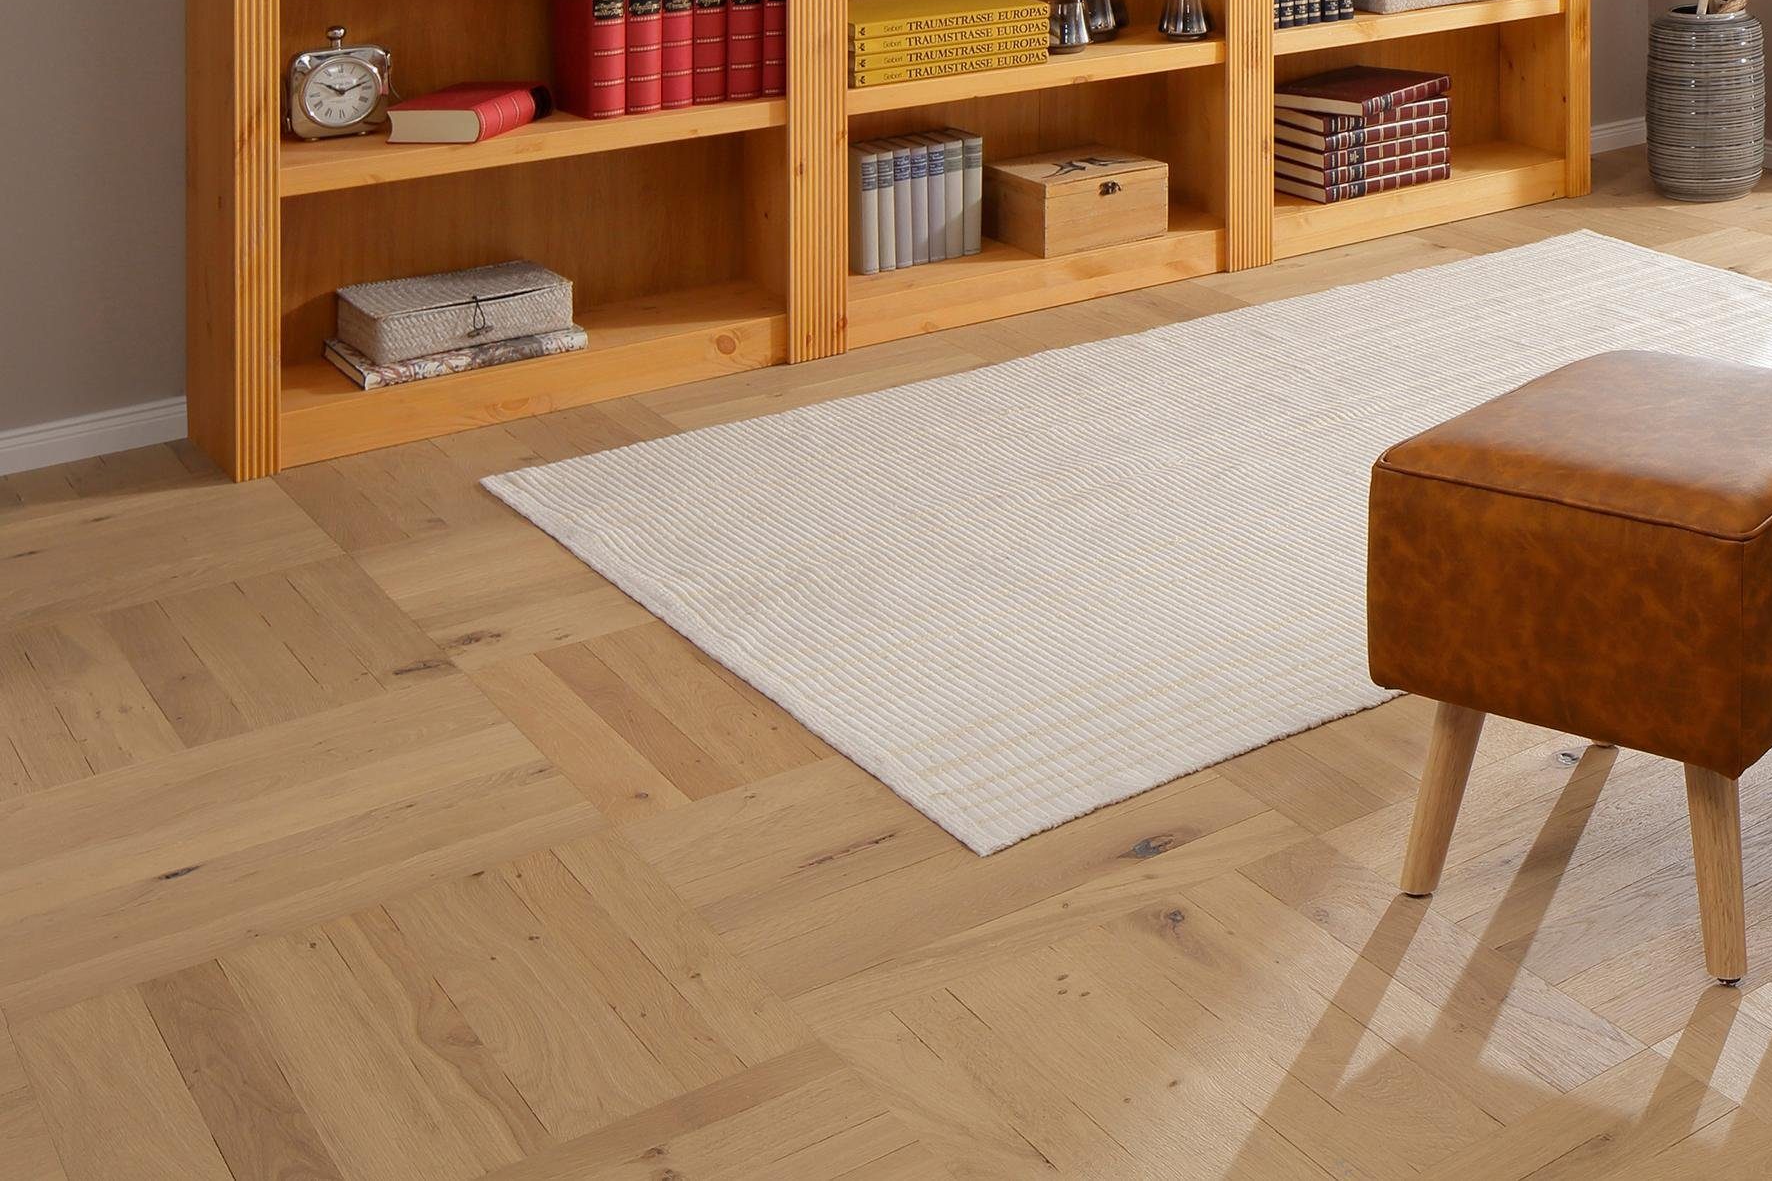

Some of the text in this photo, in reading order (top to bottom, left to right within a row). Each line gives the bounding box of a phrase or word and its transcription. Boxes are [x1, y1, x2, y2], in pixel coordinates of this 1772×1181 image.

[906, 13, 994, 32] TRAUMSTRASSE
[998, 6, 1048, 21] EUROPAS
[906, 27, 992, 47] TRAUMSTRASSE
[997, 21, 1048, 36] EUROPAS
[906, 43, 994, 63] TRAUMSTRASSE
[997, 36, 1048, 51] EUROPAS
[906, 59, 993, 79] TRAUMSTRASSE
[997, 51, 1047, 67] EUROPAS
